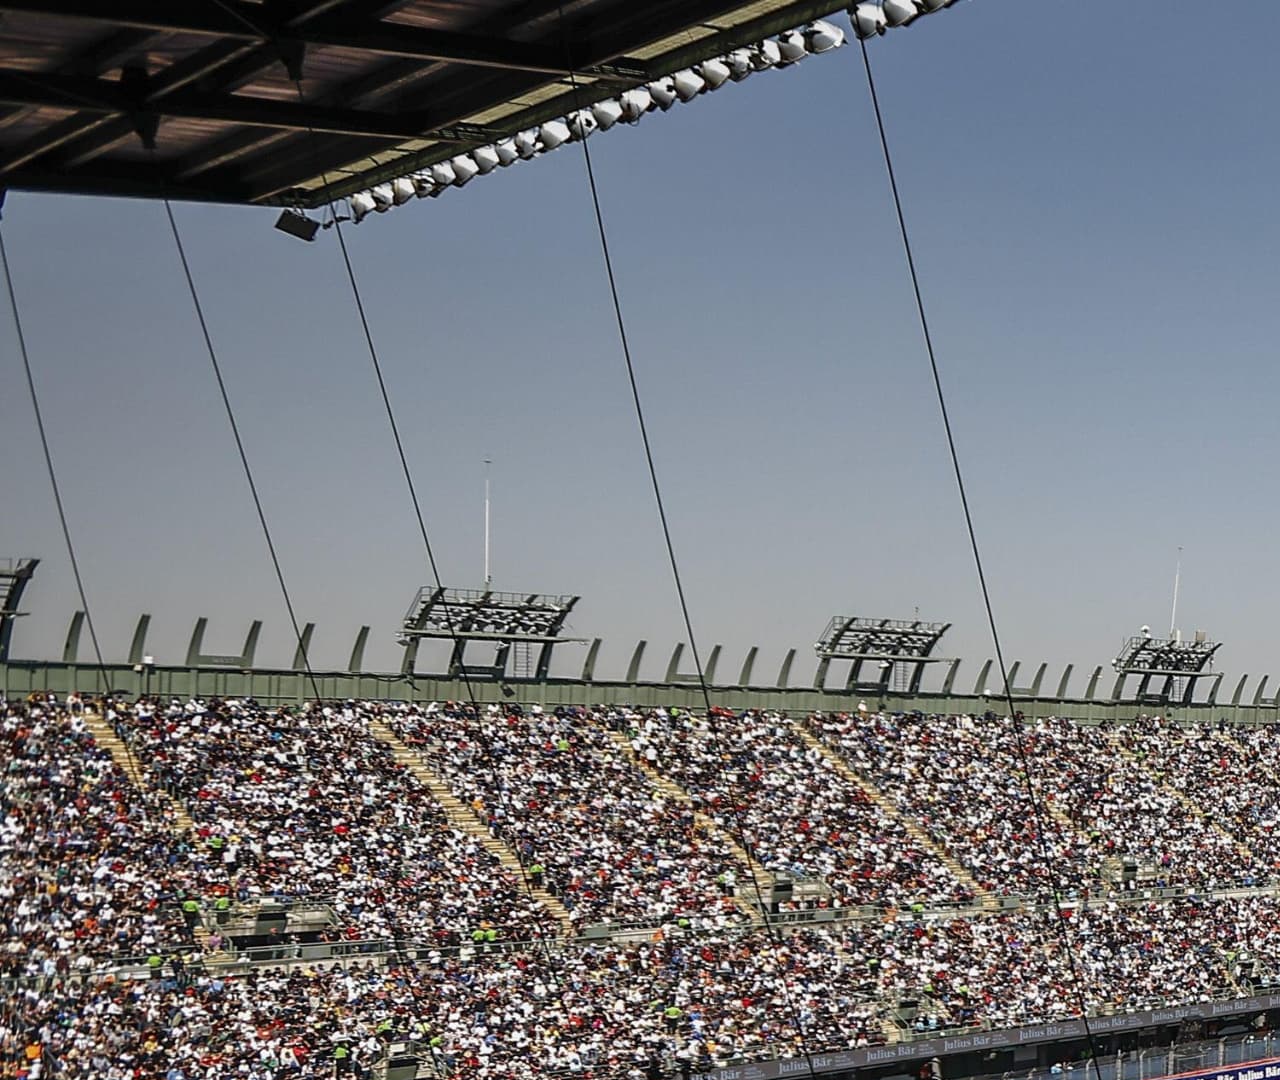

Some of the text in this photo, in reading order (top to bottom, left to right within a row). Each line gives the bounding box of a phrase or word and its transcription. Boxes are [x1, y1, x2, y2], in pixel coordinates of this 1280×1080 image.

[866, 1046, 916, 1062] Julius Bär
[778, 1058, 832, 1075] Julius Bär
